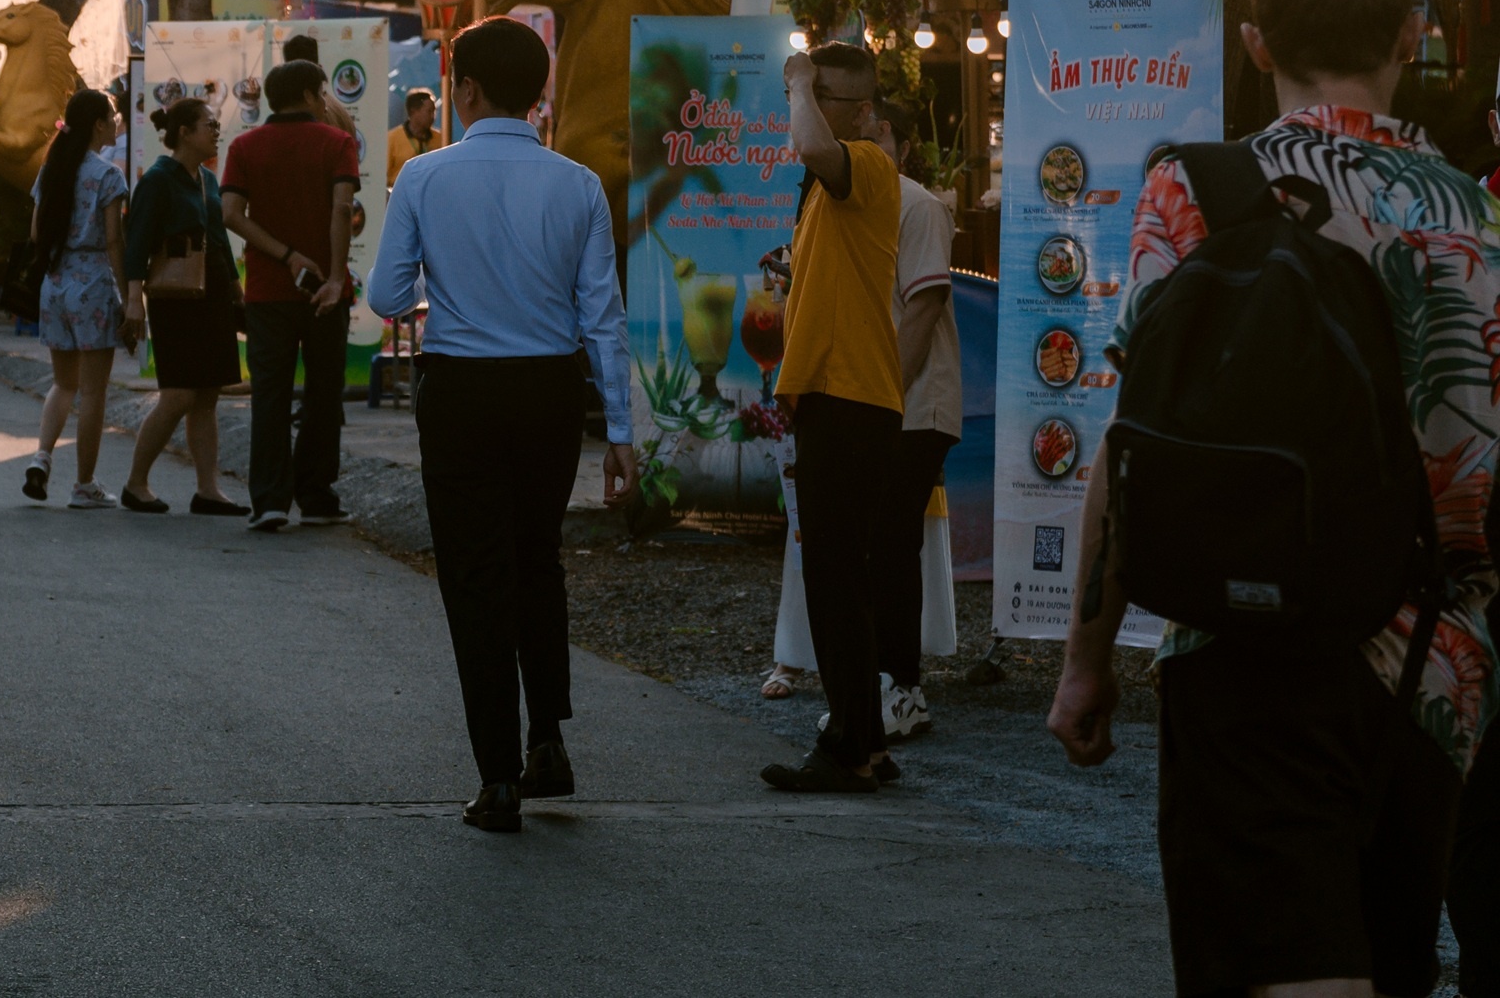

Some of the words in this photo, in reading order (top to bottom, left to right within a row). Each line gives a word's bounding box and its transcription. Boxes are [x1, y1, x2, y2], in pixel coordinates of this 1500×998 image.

[1051, 50, 1081, 92] ẨM
[1090, 53, 1139, 89] THỰC
[1146, 50, 1191, 89] BIỂN
[681, 89, 706, 128] Ở
[703, 99, 746, 141] đây
[747, 114, 765, 133] có
[1086, 100, 1122, 123] VIỆT
[1127, 102, 1165, 121] NAM
[663, 131, 741, 166] Nước
[1035, 600, 1045, 608] AN
